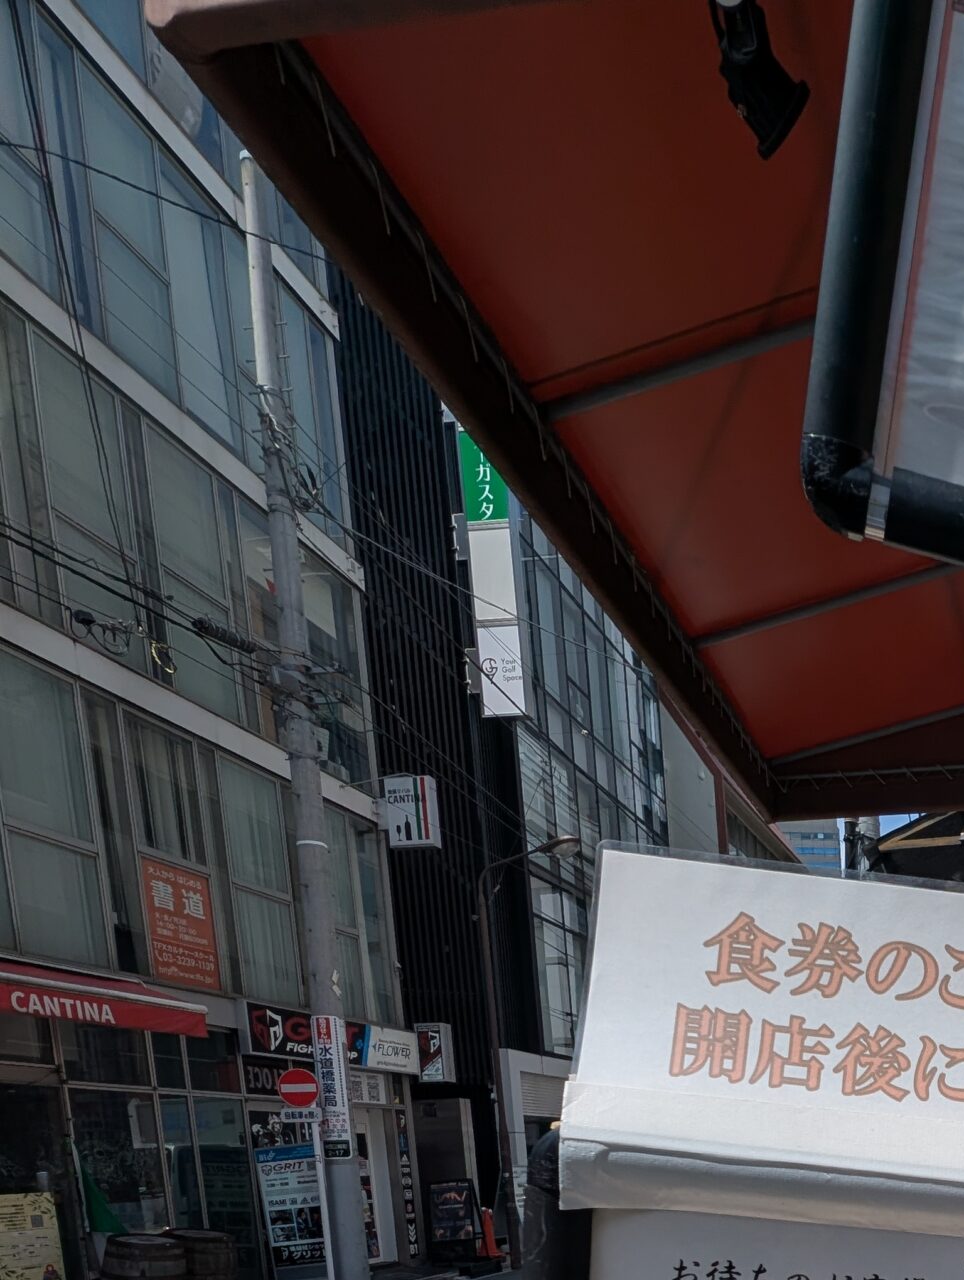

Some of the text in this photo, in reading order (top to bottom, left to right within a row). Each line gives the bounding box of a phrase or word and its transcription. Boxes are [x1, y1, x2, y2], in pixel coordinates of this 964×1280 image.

[474, 446, 494, 521] ーガスタ
[501, 665, 516, 673] Golf
[150, 879, 206, 920] 書道
[11, 991, 116, 1025] CANTINA
[377, 1042, 411, 1060] FLOWER
[319, 1045, 338, 1108] 水道橋薬局
[284, 1111, 319, 1120] 自転車を除く
[273, 1160, 304, 1173] GRIT
